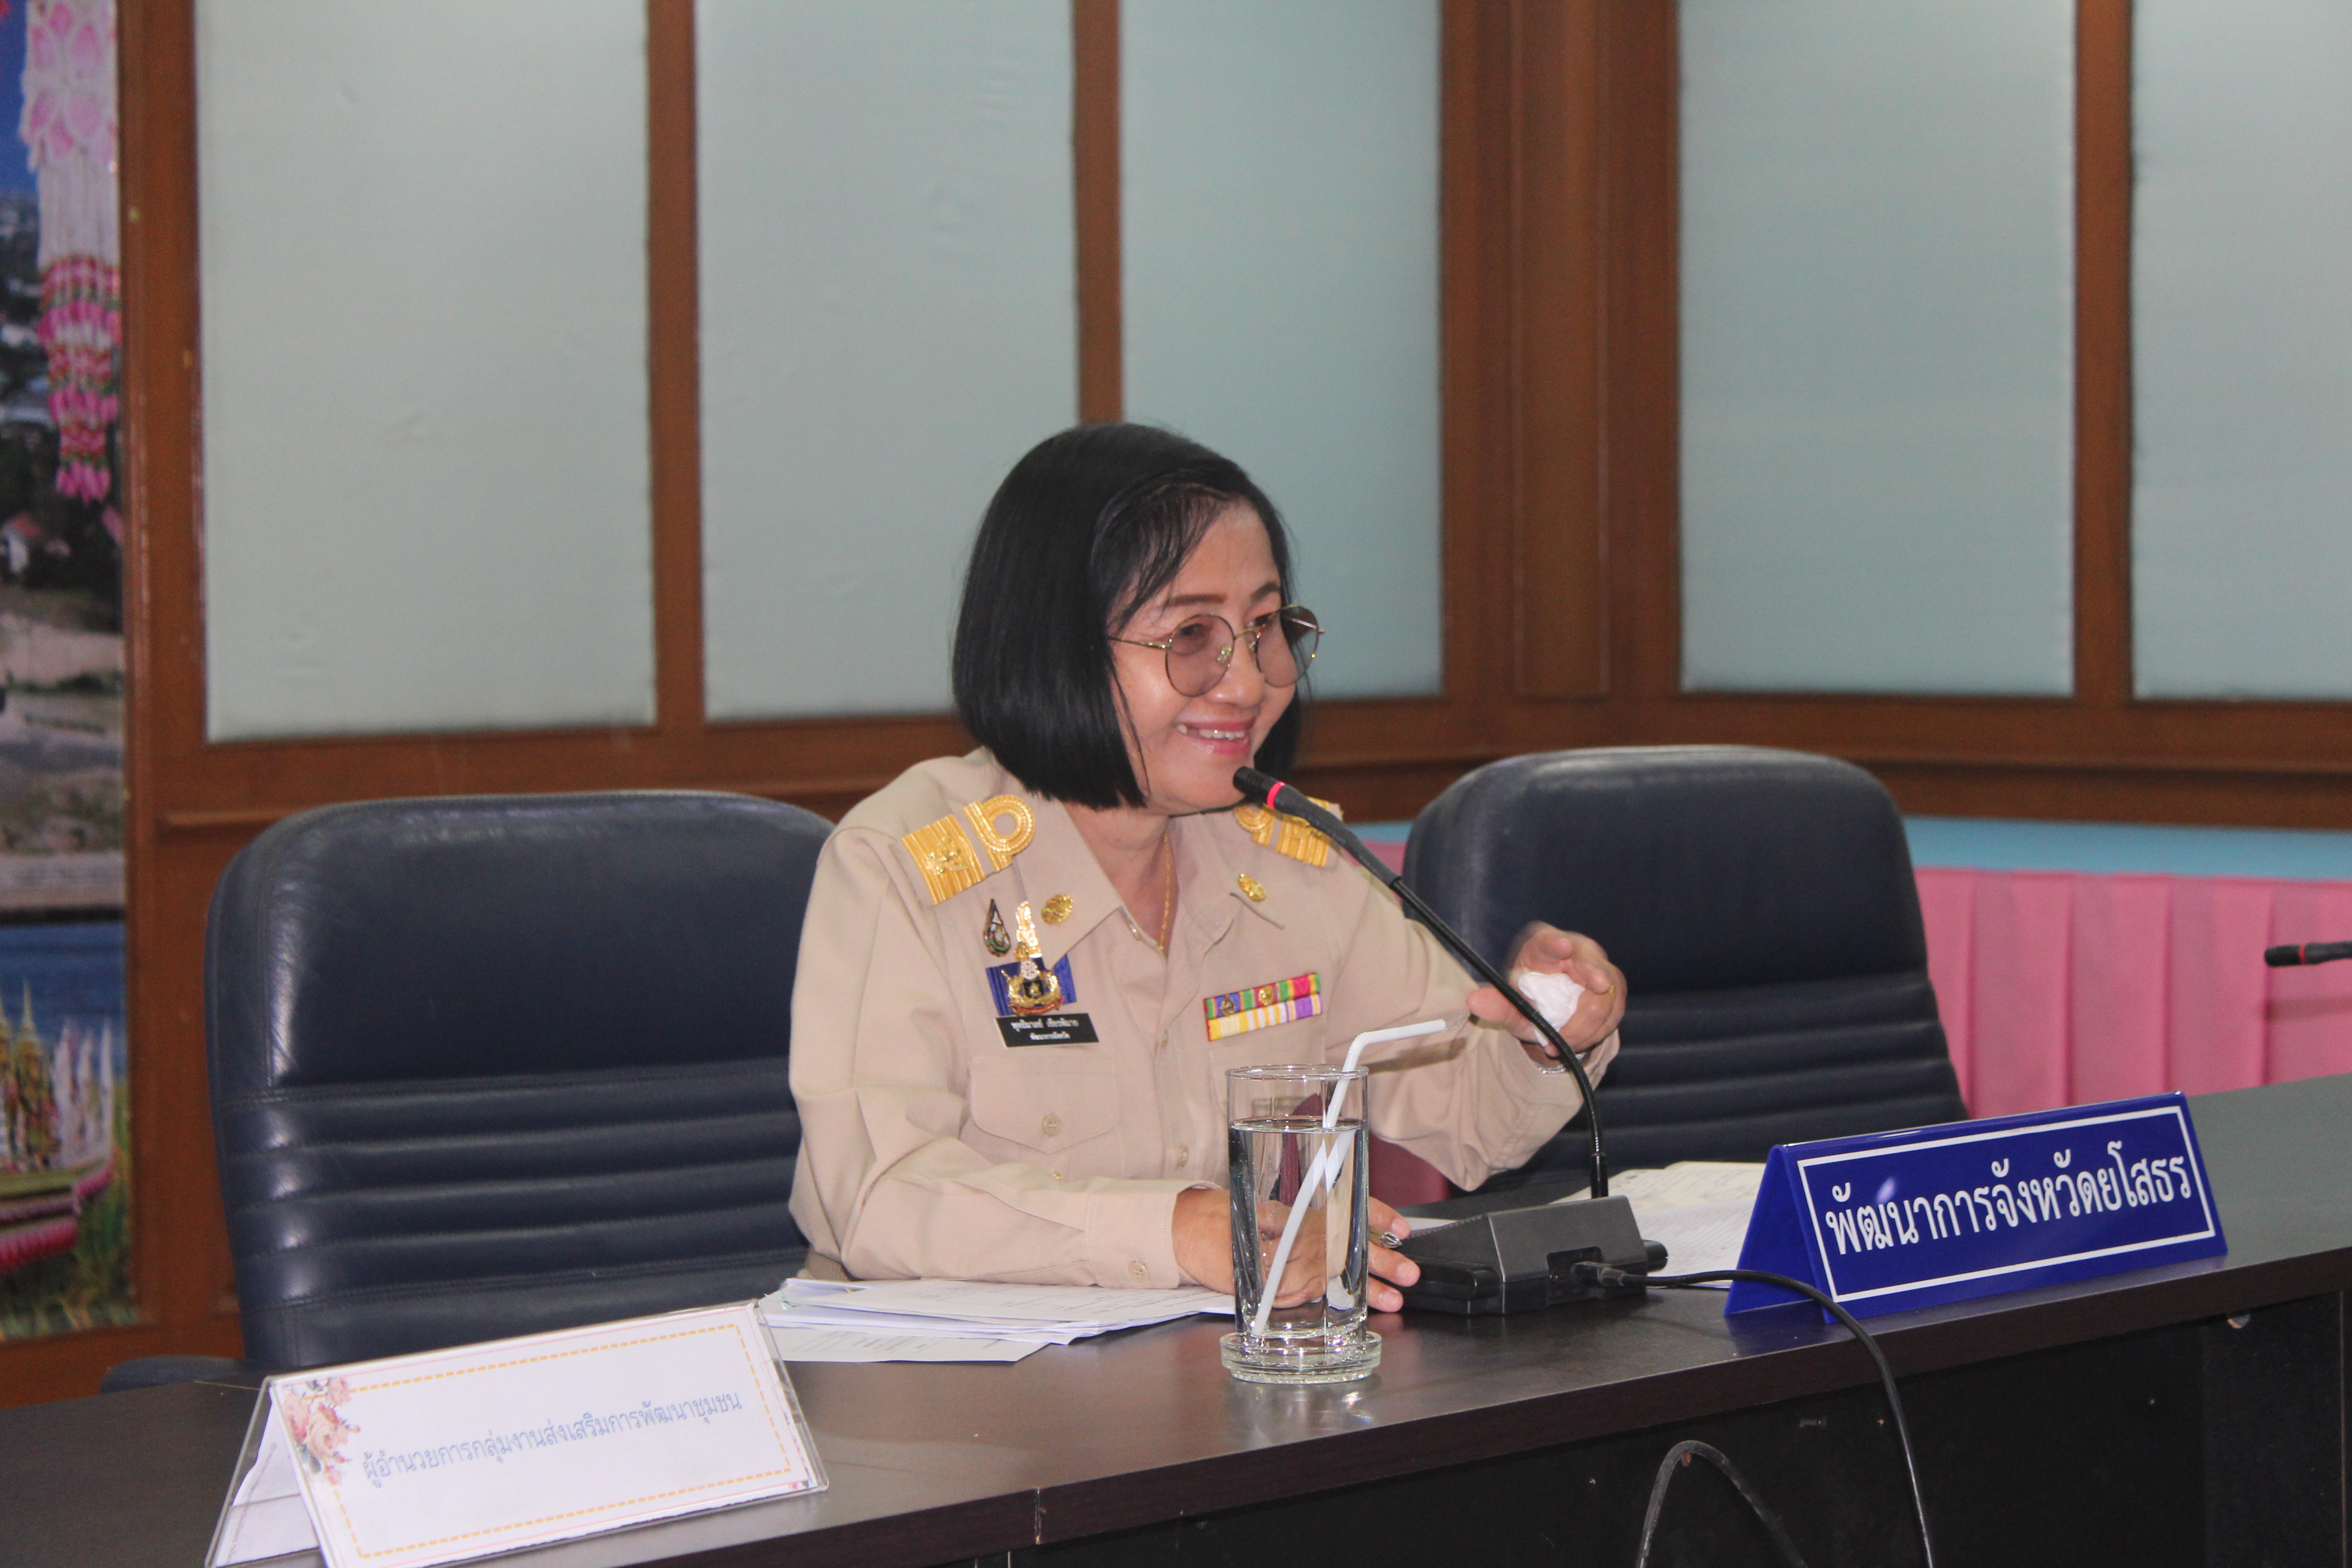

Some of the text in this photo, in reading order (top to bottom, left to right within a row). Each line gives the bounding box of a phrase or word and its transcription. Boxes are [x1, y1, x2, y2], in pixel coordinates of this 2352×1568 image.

[1825, 1141, 2191, 1255] พัฒนาการจังหวัดยโสธร
[362, 1392, 743, 1489] ผู้อำนวยการกลุ่มงานส่งเสริมการพัฒนาชุมชน
